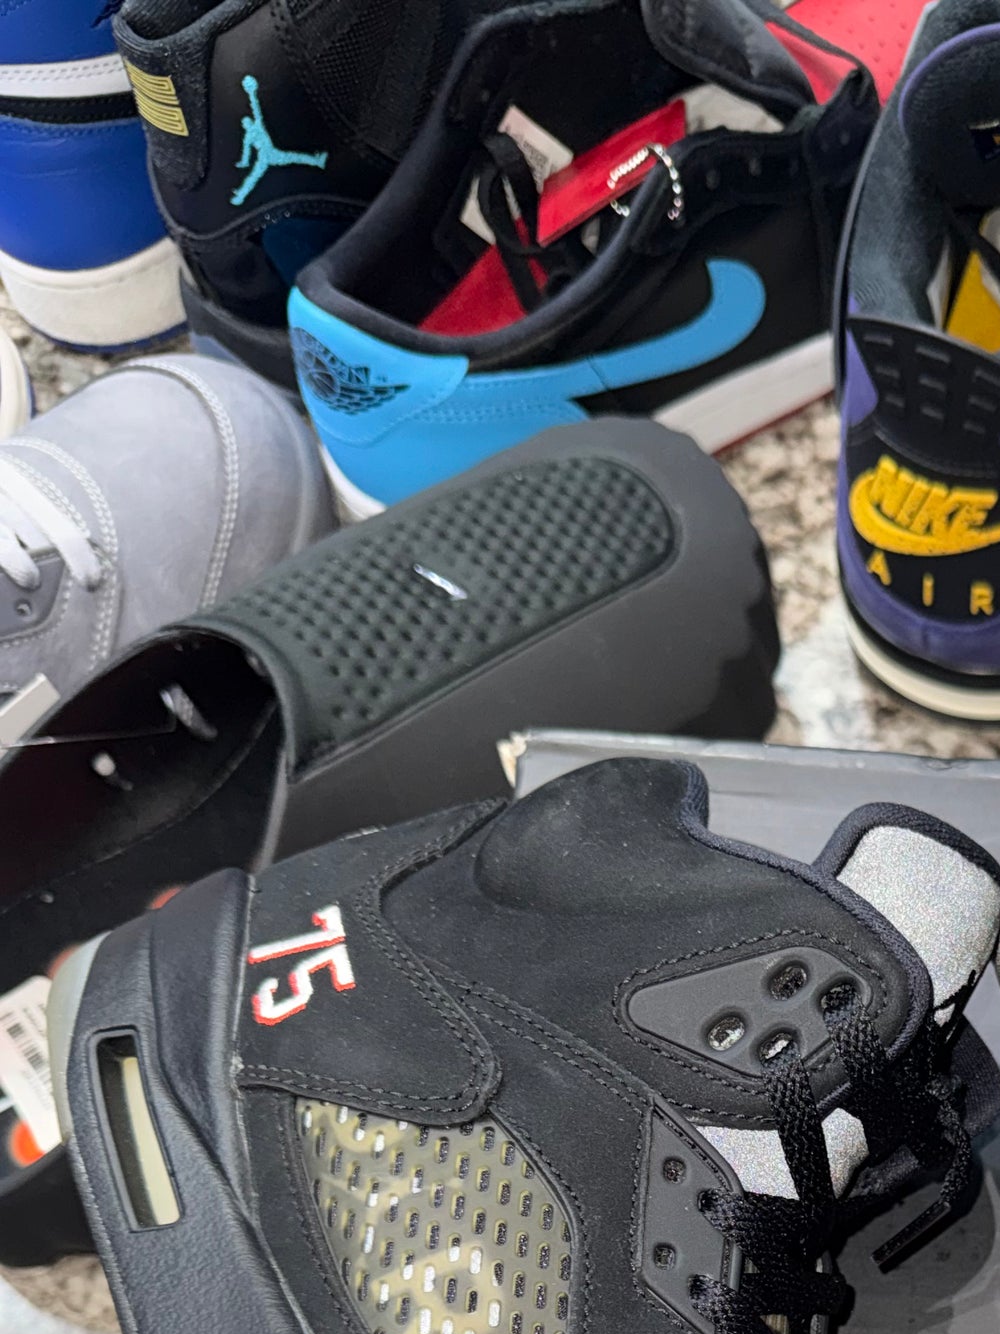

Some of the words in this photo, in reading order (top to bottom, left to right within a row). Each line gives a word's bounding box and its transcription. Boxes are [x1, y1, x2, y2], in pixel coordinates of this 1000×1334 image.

[868, 454, 998, 538] NIKE
[866, 550, 995, 616] AIR
[247, 904, 357, 1026] 75
